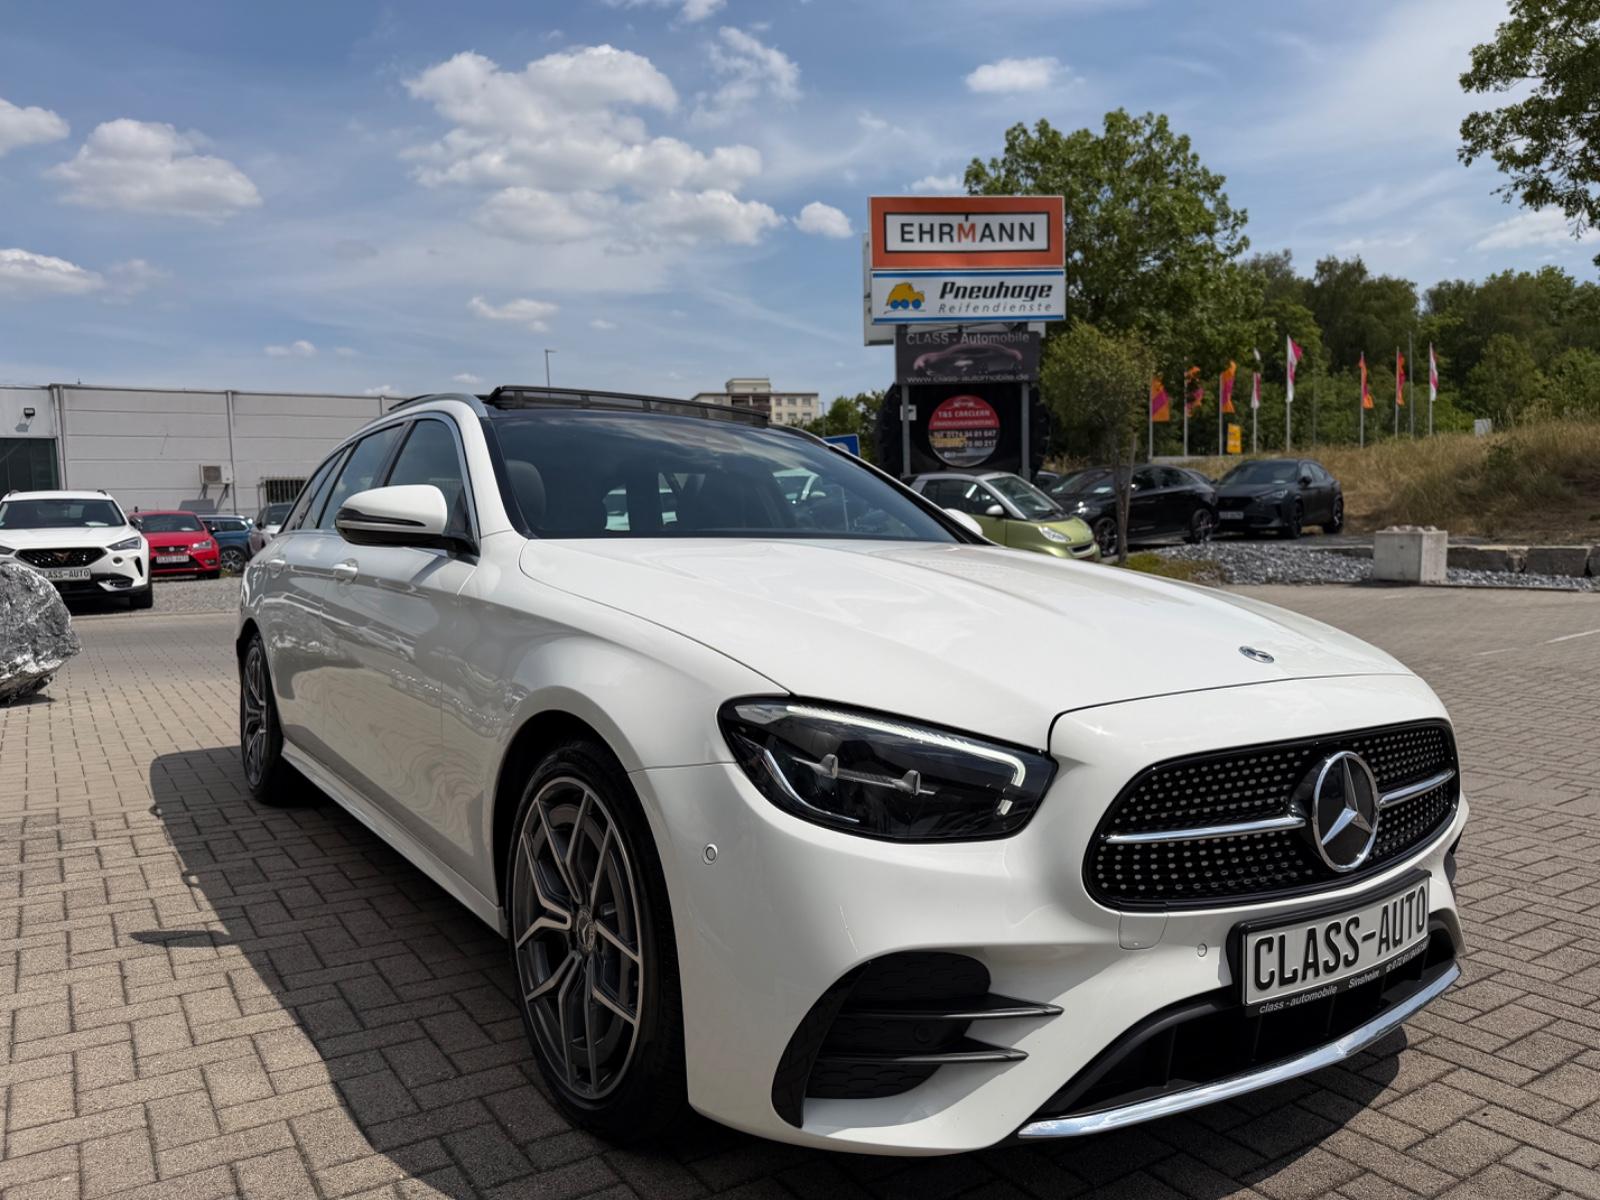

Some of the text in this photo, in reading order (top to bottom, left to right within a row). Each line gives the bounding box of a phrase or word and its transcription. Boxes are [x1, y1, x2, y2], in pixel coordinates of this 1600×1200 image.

[900, 221, 1036, 244] EHRMANN
[939, 281, 1053, 303] Pneuhage
[938, 302, 1053, 314] Reifendienste
[906, 332, 950, 346] CLASS
[961, 331, 1030, 345] Automobile
[1253, 885, 1427, 991] CLASS-AUTO
